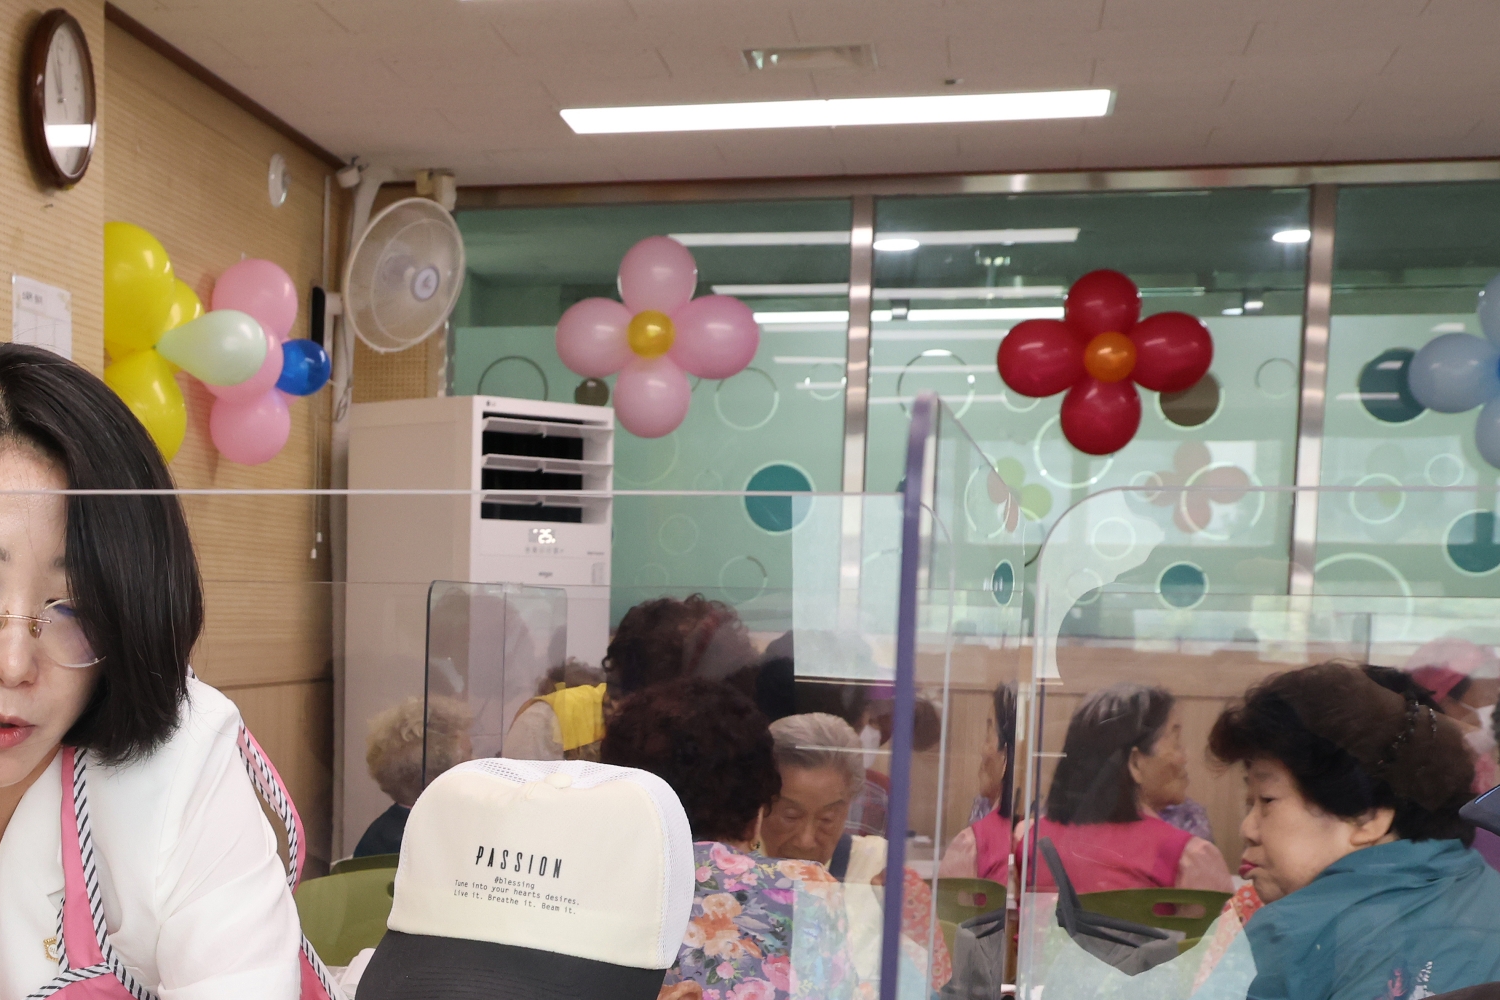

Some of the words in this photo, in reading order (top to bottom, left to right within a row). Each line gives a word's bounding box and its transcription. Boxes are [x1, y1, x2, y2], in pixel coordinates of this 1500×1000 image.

[476, 846, 562, 878] PASSION
[472, 881, 488, 890] into
[514, 888, 540, 898] hearts
[545, 894, 579, 905] desires.
[494, 876, 535, 890] @blessing
[472, 891, 483, 900] it.
[487, 894, 519, 905] Breathe
[524, 899, 536, 908] it.
[541, 902, 560, 911] Beam
[564, 906, 576, 915] it.
